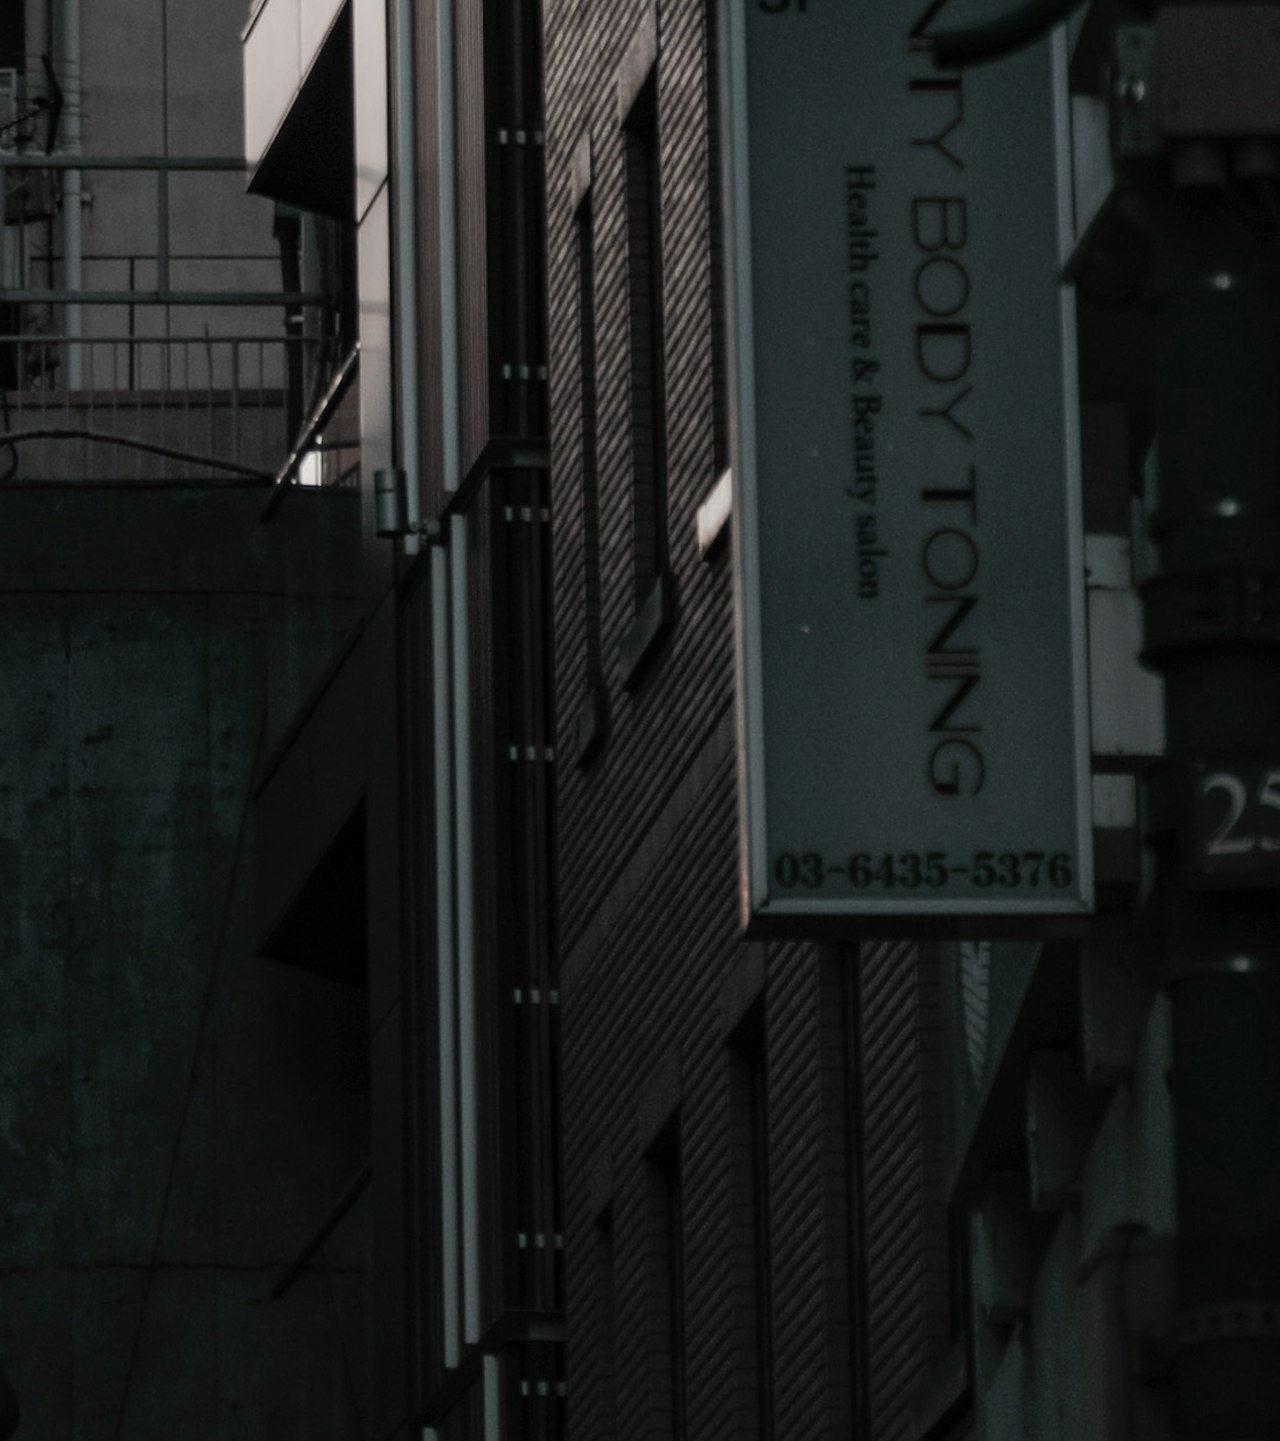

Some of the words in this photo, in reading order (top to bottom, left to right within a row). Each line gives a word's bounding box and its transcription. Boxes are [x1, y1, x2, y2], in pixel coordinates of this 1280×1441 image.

[845, 163, 880, 272] Health
[849, 281, 872, 349] care
[910, 195, 974, 444] BODY
[852, 357, 881, 385] &
[845, 395, 883, 506] Beauty
[856, 513, 888, 600] salon
[920, 464, 986, 798] TONING
[774, 852, 1073, 889] 03-6435-5376
